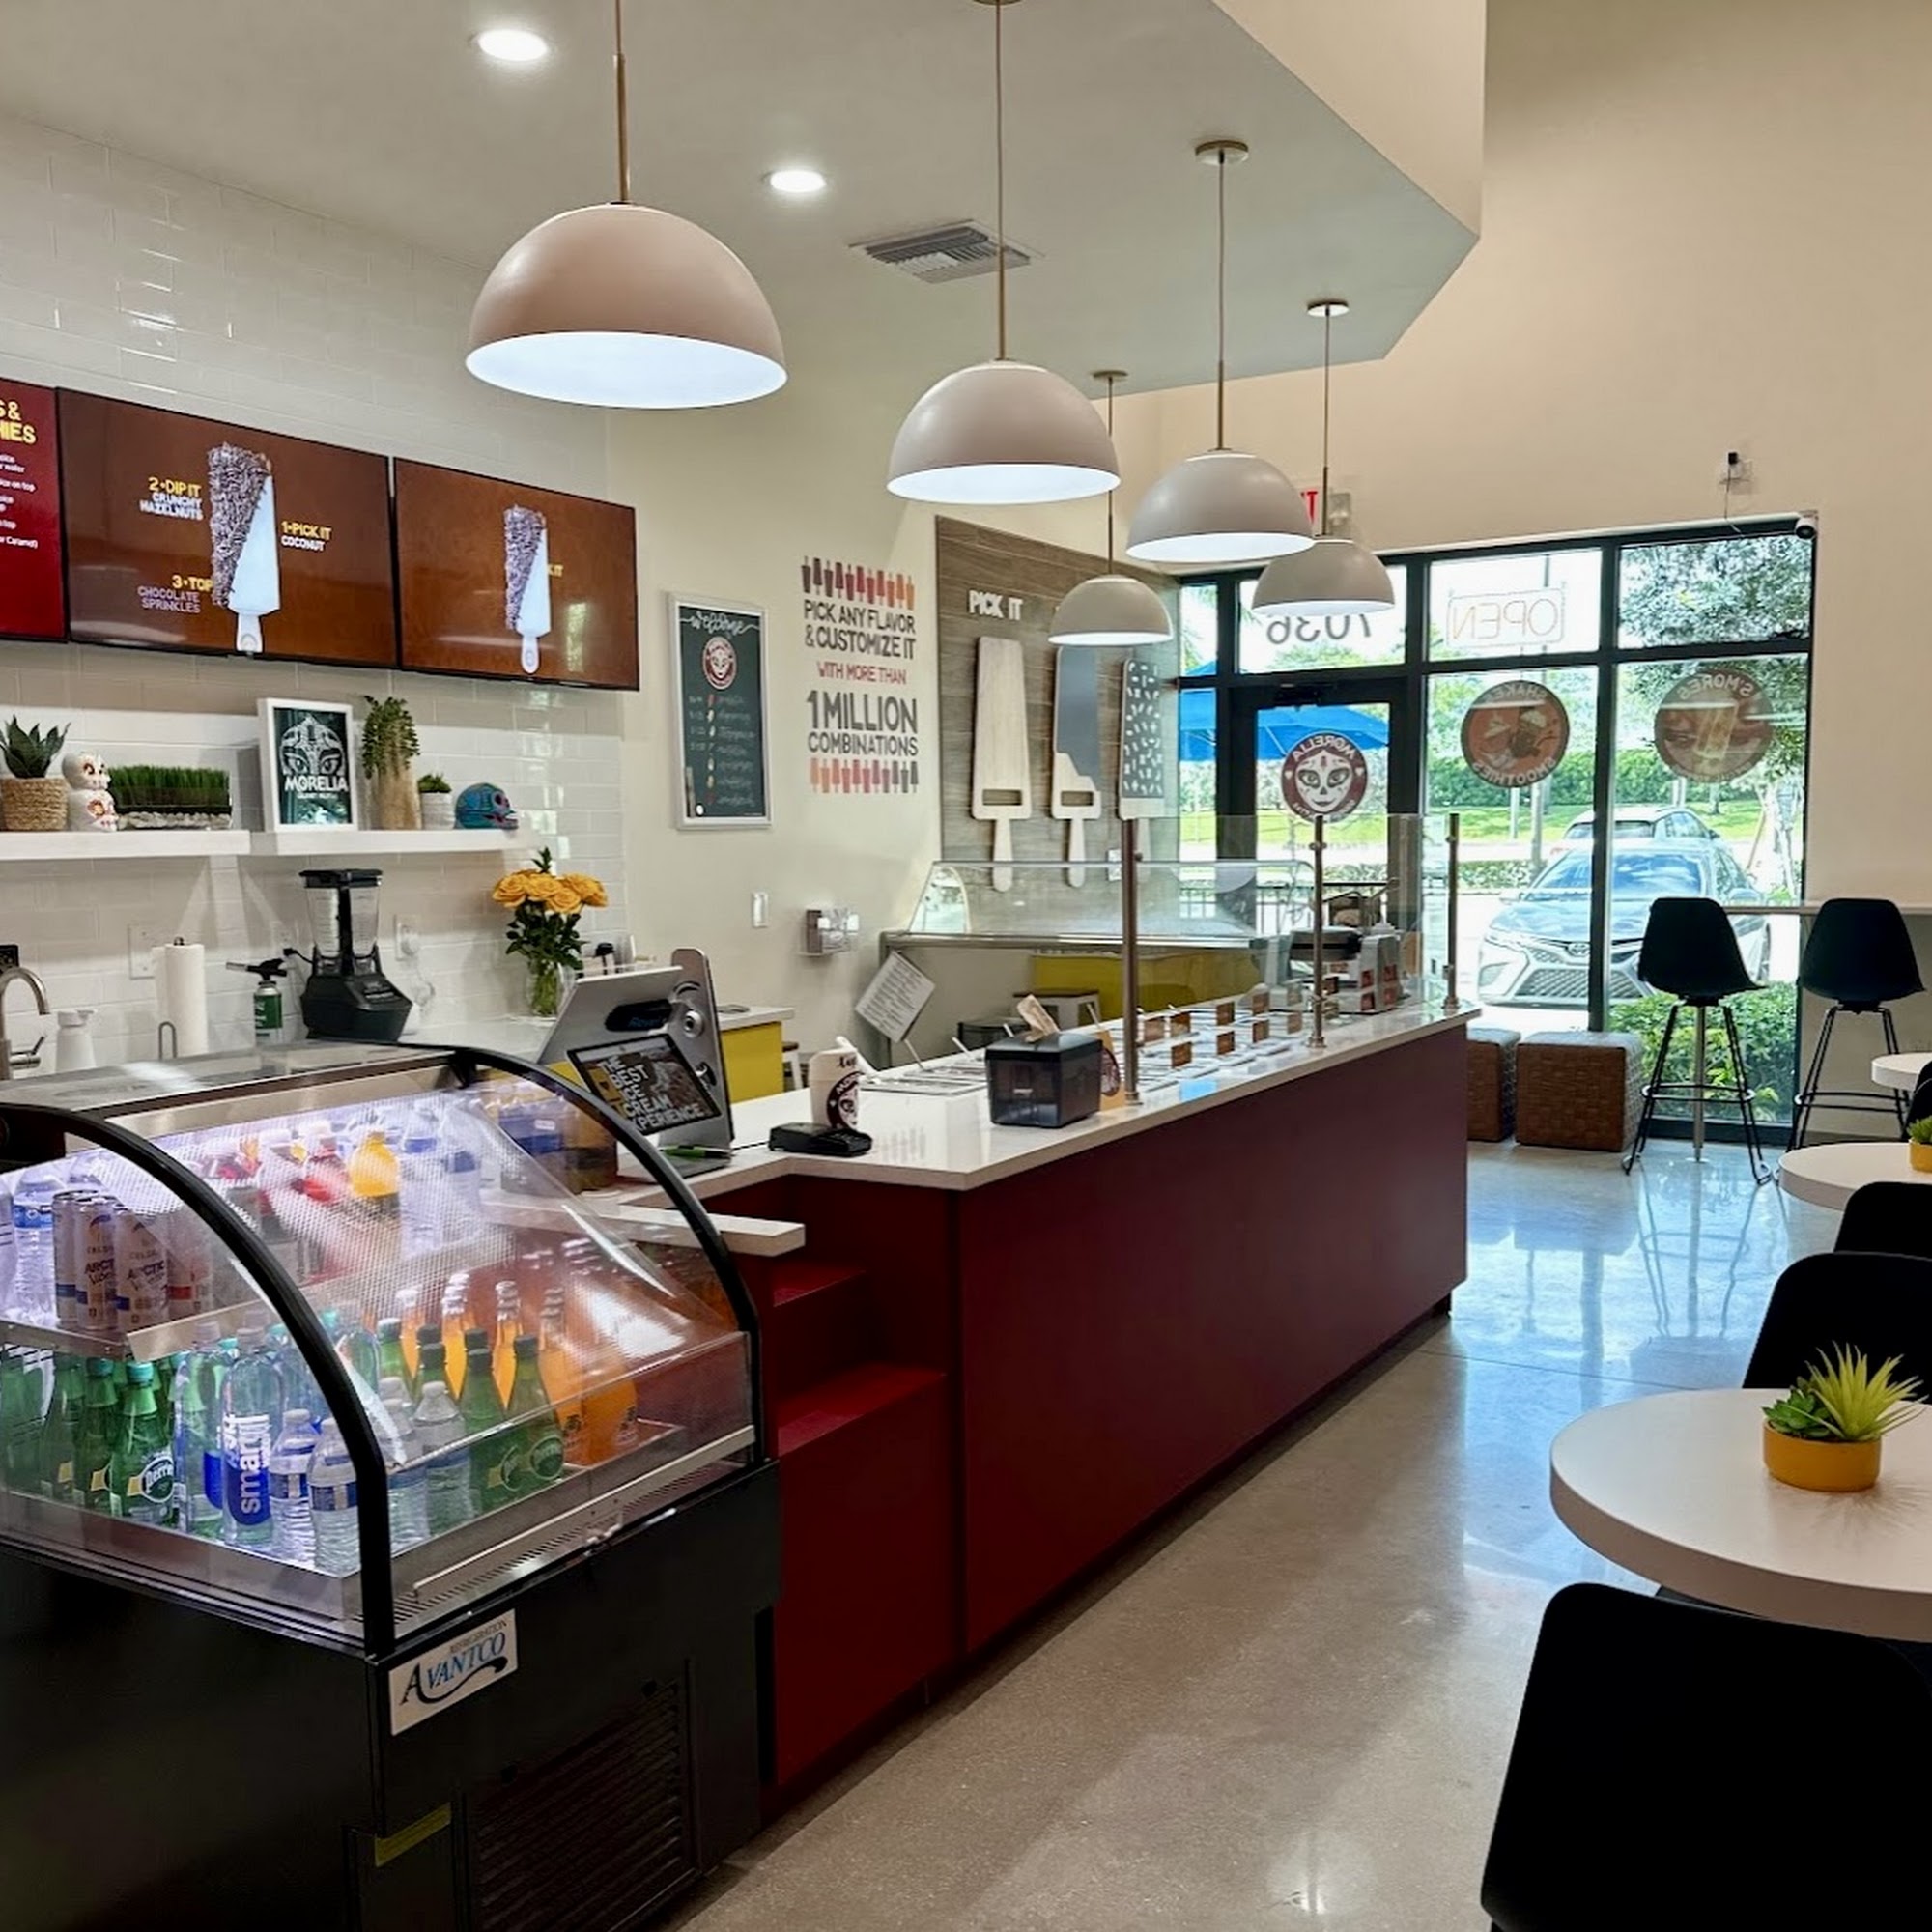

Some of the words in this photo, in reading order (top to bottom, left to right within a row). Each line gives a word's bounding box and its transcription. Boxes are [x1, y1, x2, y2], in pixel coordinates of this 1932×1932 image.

[187, 483, 202, 497] IT
[137, 585, 200, 603] CHOCOLATE
[141, 597, 201, 614] SPRINKLES
[969, 590, 1004, 618] PICK
[1009, 597, 1024, 621] IT
[804, 599, 837, 624] PICK
[838, 606, 867, 627] ANY
[868, 610, 916, 635] FLAVOR
[805, 624, 815, 648] &
[816, 628, 901, 659] CUSTOMIZE
[903, 638, 917, 660] IT
[817, 661, 844, 680] WITH
[846, 664, 876, 683] MORE
[877, 667, 907, 685] THAN
[399, 666, 506, 741] AVANTCO
[806, 690, 819, 729] 1
[823, 691, 918, 734] MILLION
[808, 731, 919, 757] COMBINATIONS
[284, 775, 349, 792] MORELIA
[608, 1064, 650, 1089] BEST
[621, 1094, 674, 1120] CREAM
[631, 1102, 705, 1131] XPERIENCE
